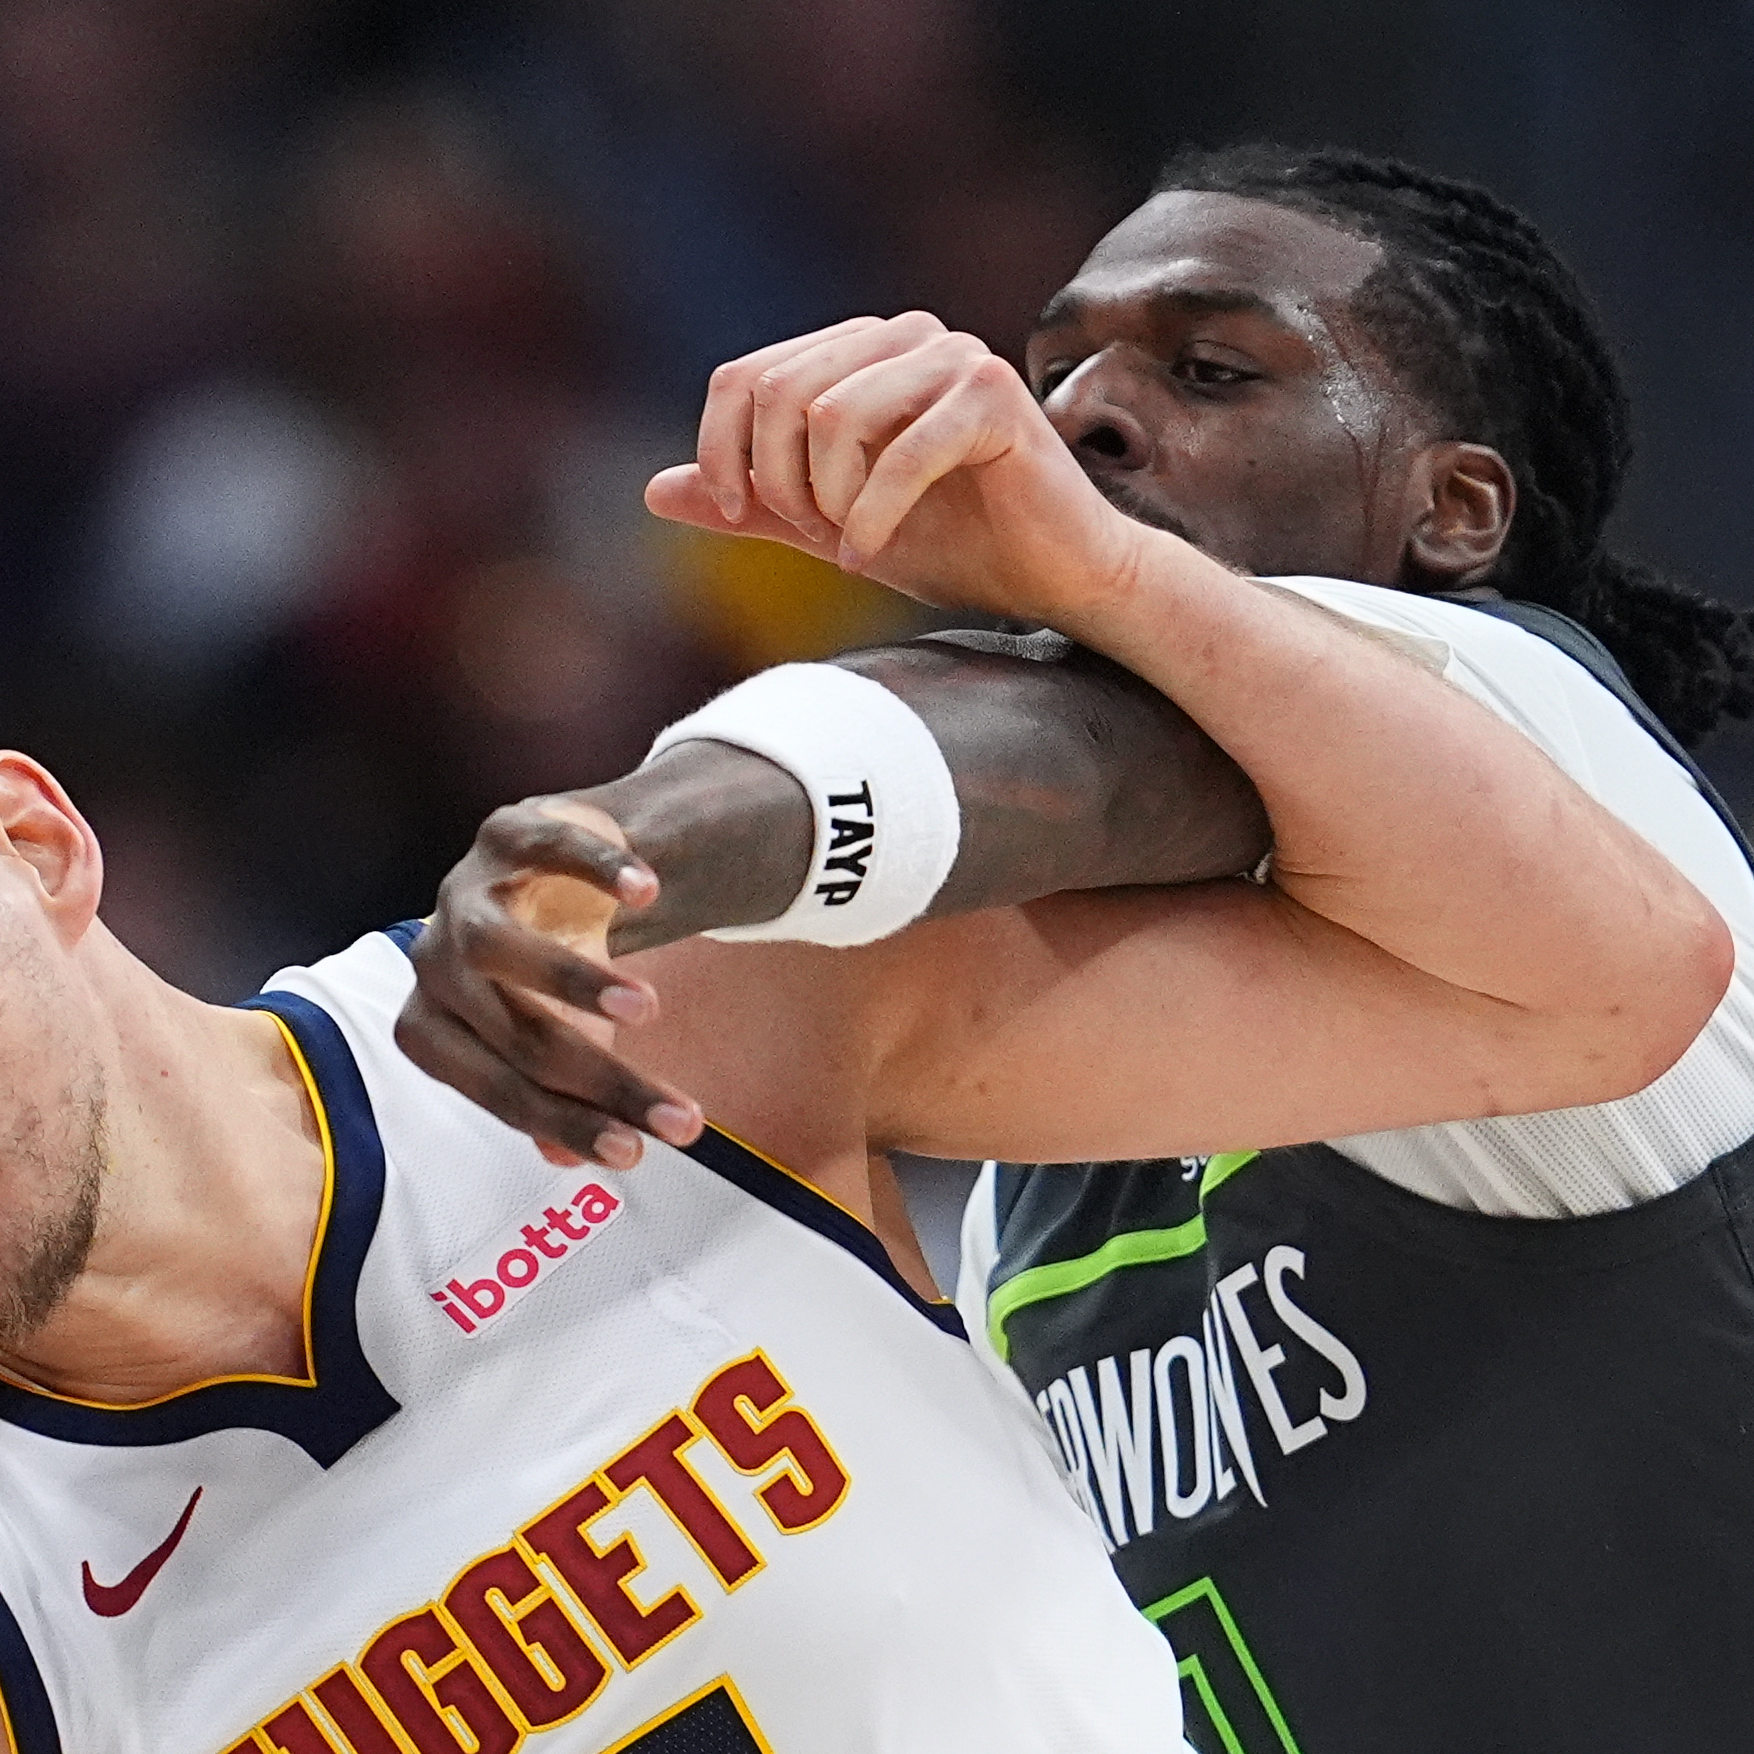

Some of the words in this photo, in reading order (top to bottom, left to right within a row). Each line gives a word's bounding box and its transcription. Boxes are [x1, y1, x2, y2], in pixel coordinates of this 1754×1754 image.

[814, 779, 875, 906] TAYP
[429, 1182, 622, 1334] ibotta
[1036, 1244, 1367, 1556] RWOLVES
